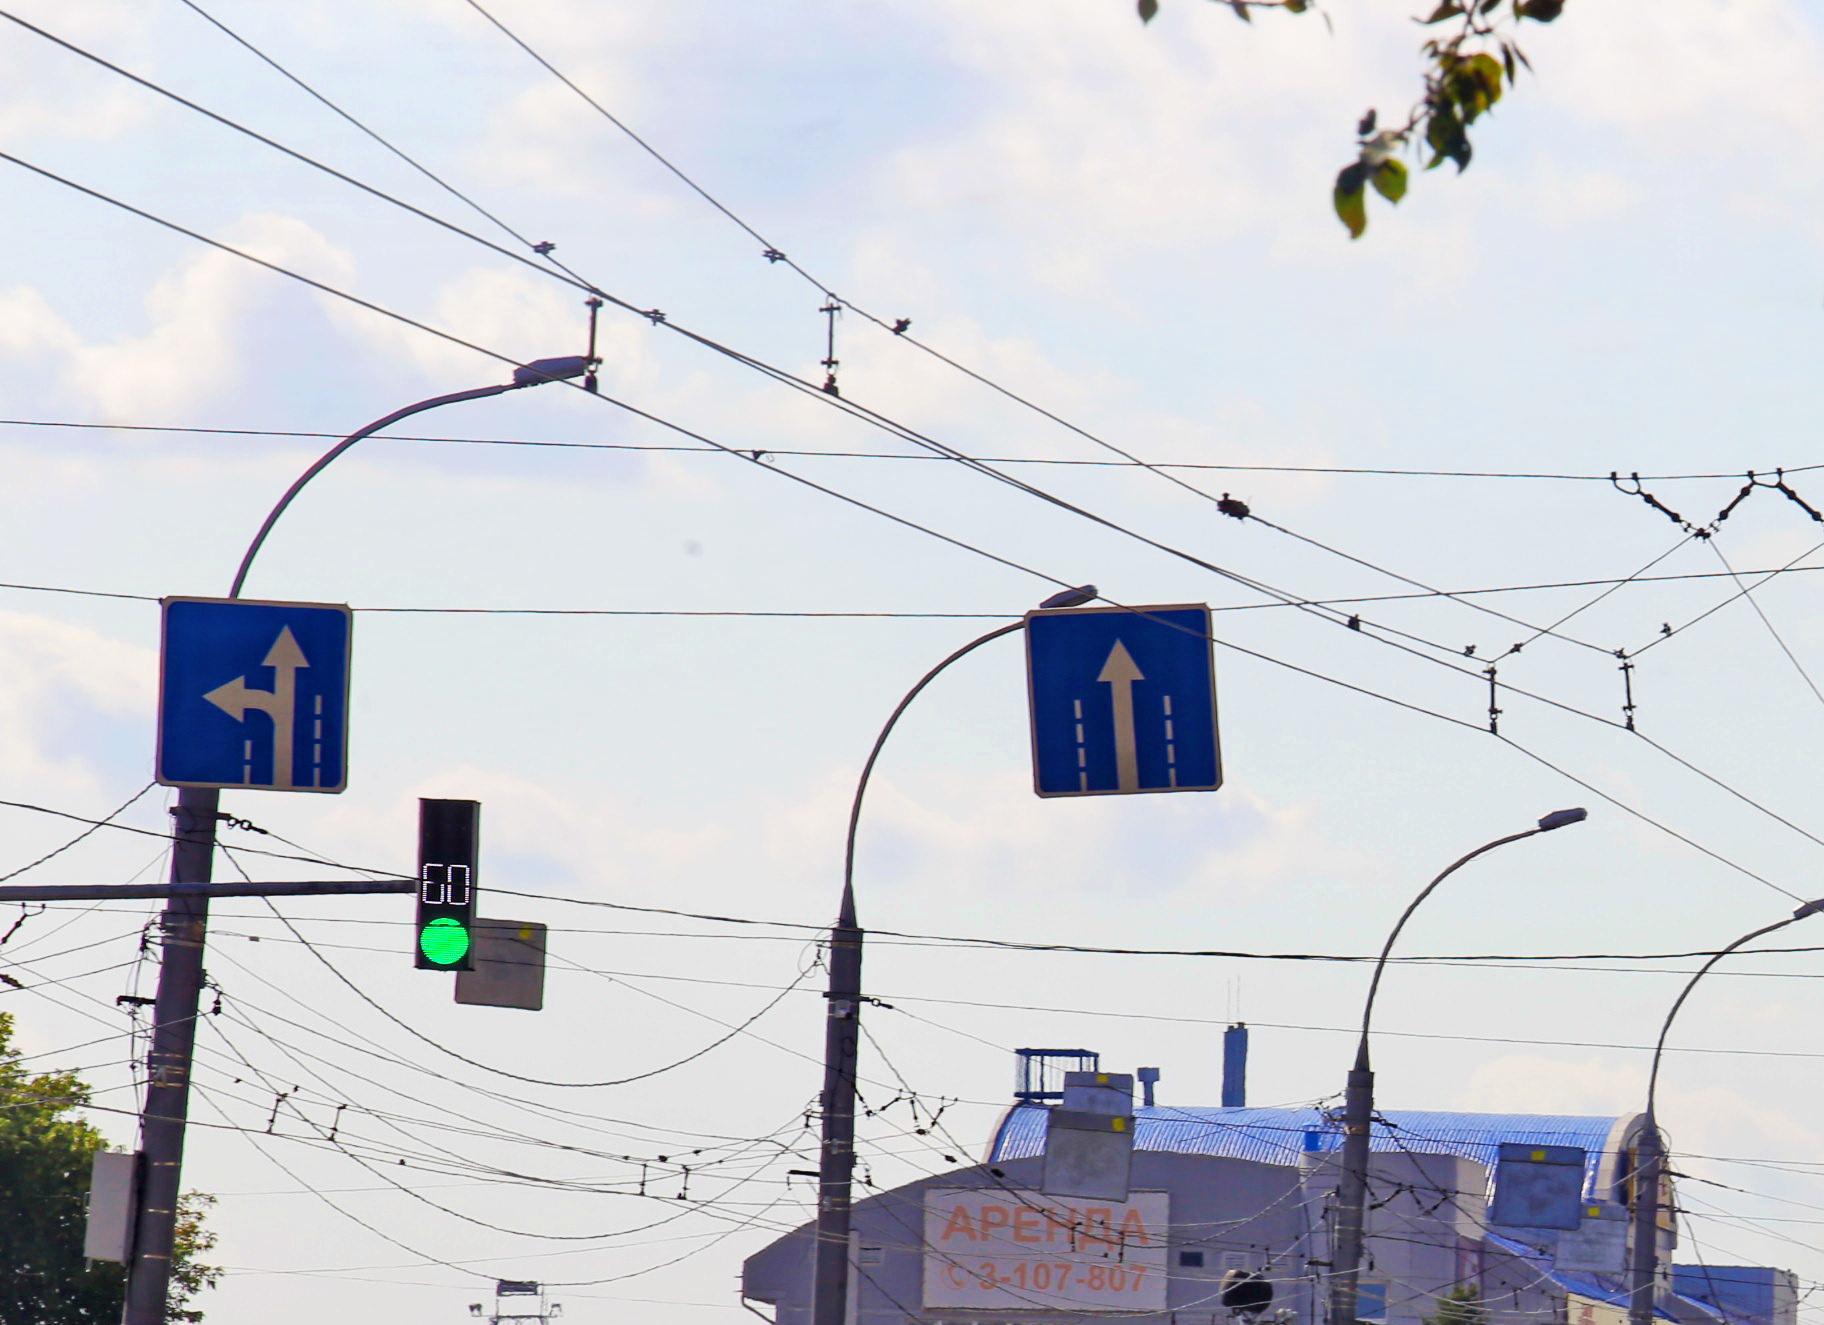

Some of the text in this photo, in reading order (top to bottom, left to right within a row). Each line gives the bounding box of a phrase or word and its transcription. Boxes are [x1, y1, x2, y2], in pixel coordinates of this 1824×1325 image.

[422, 863, 470, 905] 60
[941, 1205, 1149, 1251] АРЕНДА
[978, 1261, 1147, 1292] 3-107-807
